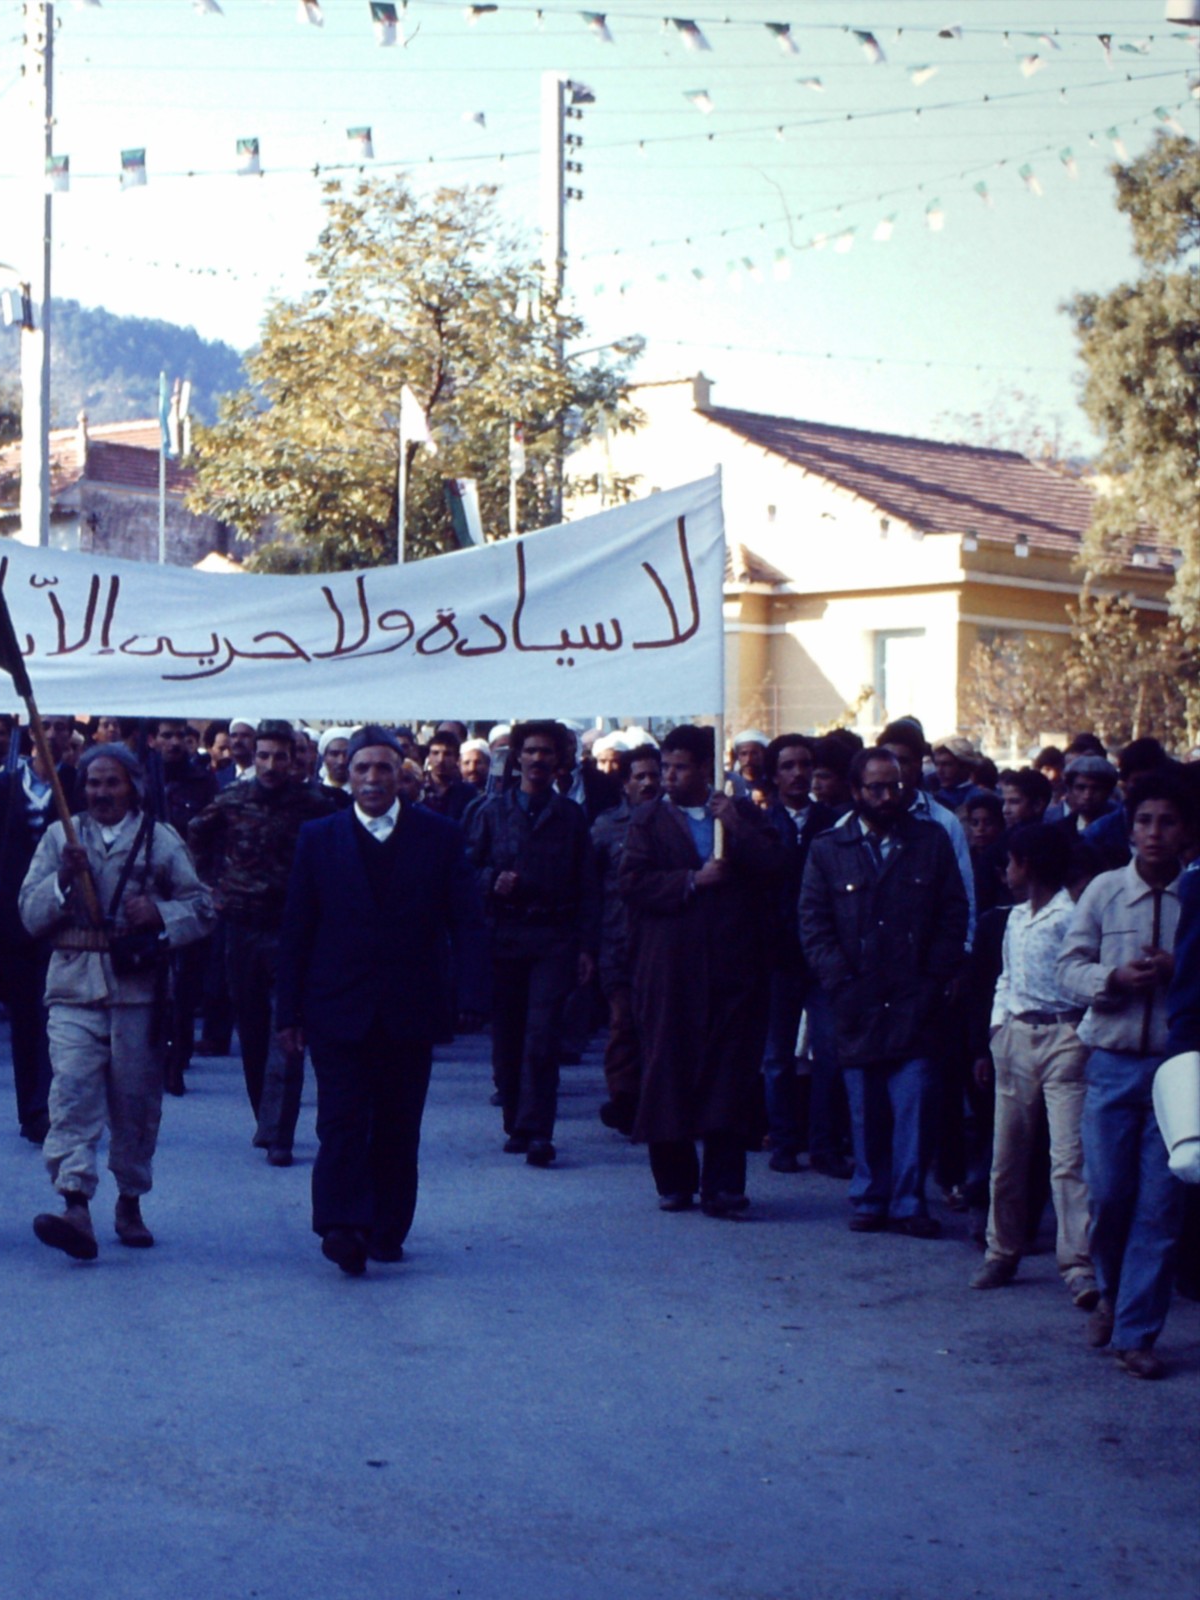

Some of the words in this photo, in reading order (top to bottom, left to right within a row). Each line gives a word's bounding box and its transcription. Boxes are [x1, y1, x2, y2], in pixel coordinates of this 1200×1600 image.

[311, 573, 415, 662] ولا
[414, 541, 624, 667] سيادة
[632, 514, 701, 649] لا
